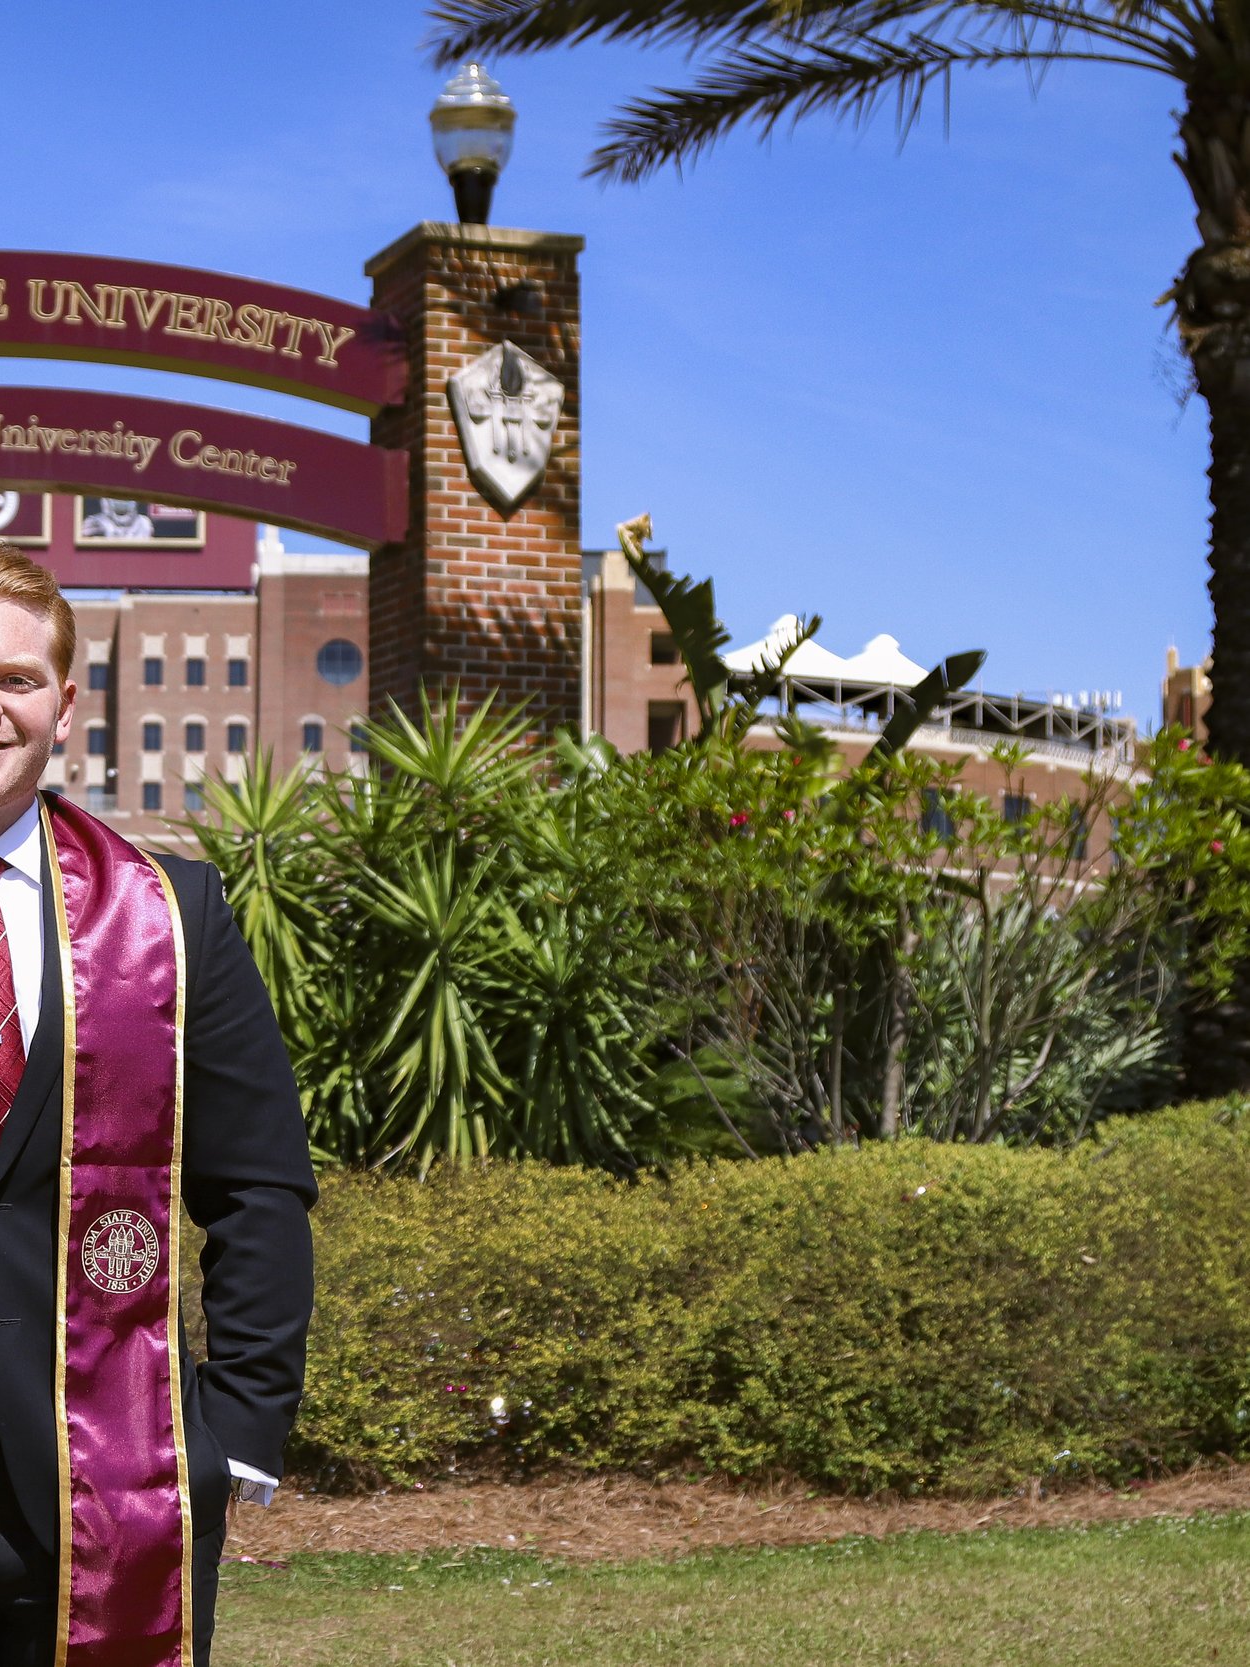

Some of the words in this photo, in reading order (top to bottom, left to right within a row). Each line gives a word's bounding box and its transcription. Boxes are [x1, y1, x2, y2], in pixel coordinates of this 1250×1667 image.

[26, 279, 356, 368] UNIVERSITY
[168, 429, 296, 486] Center
[84, 1229, 100, 1279] FLORIDA
[100, 1213, 132, 1227] STATE
[137, 1219, 157, 1283] UNIVERSITY
[106, 1280, 130, 1291] 1851
